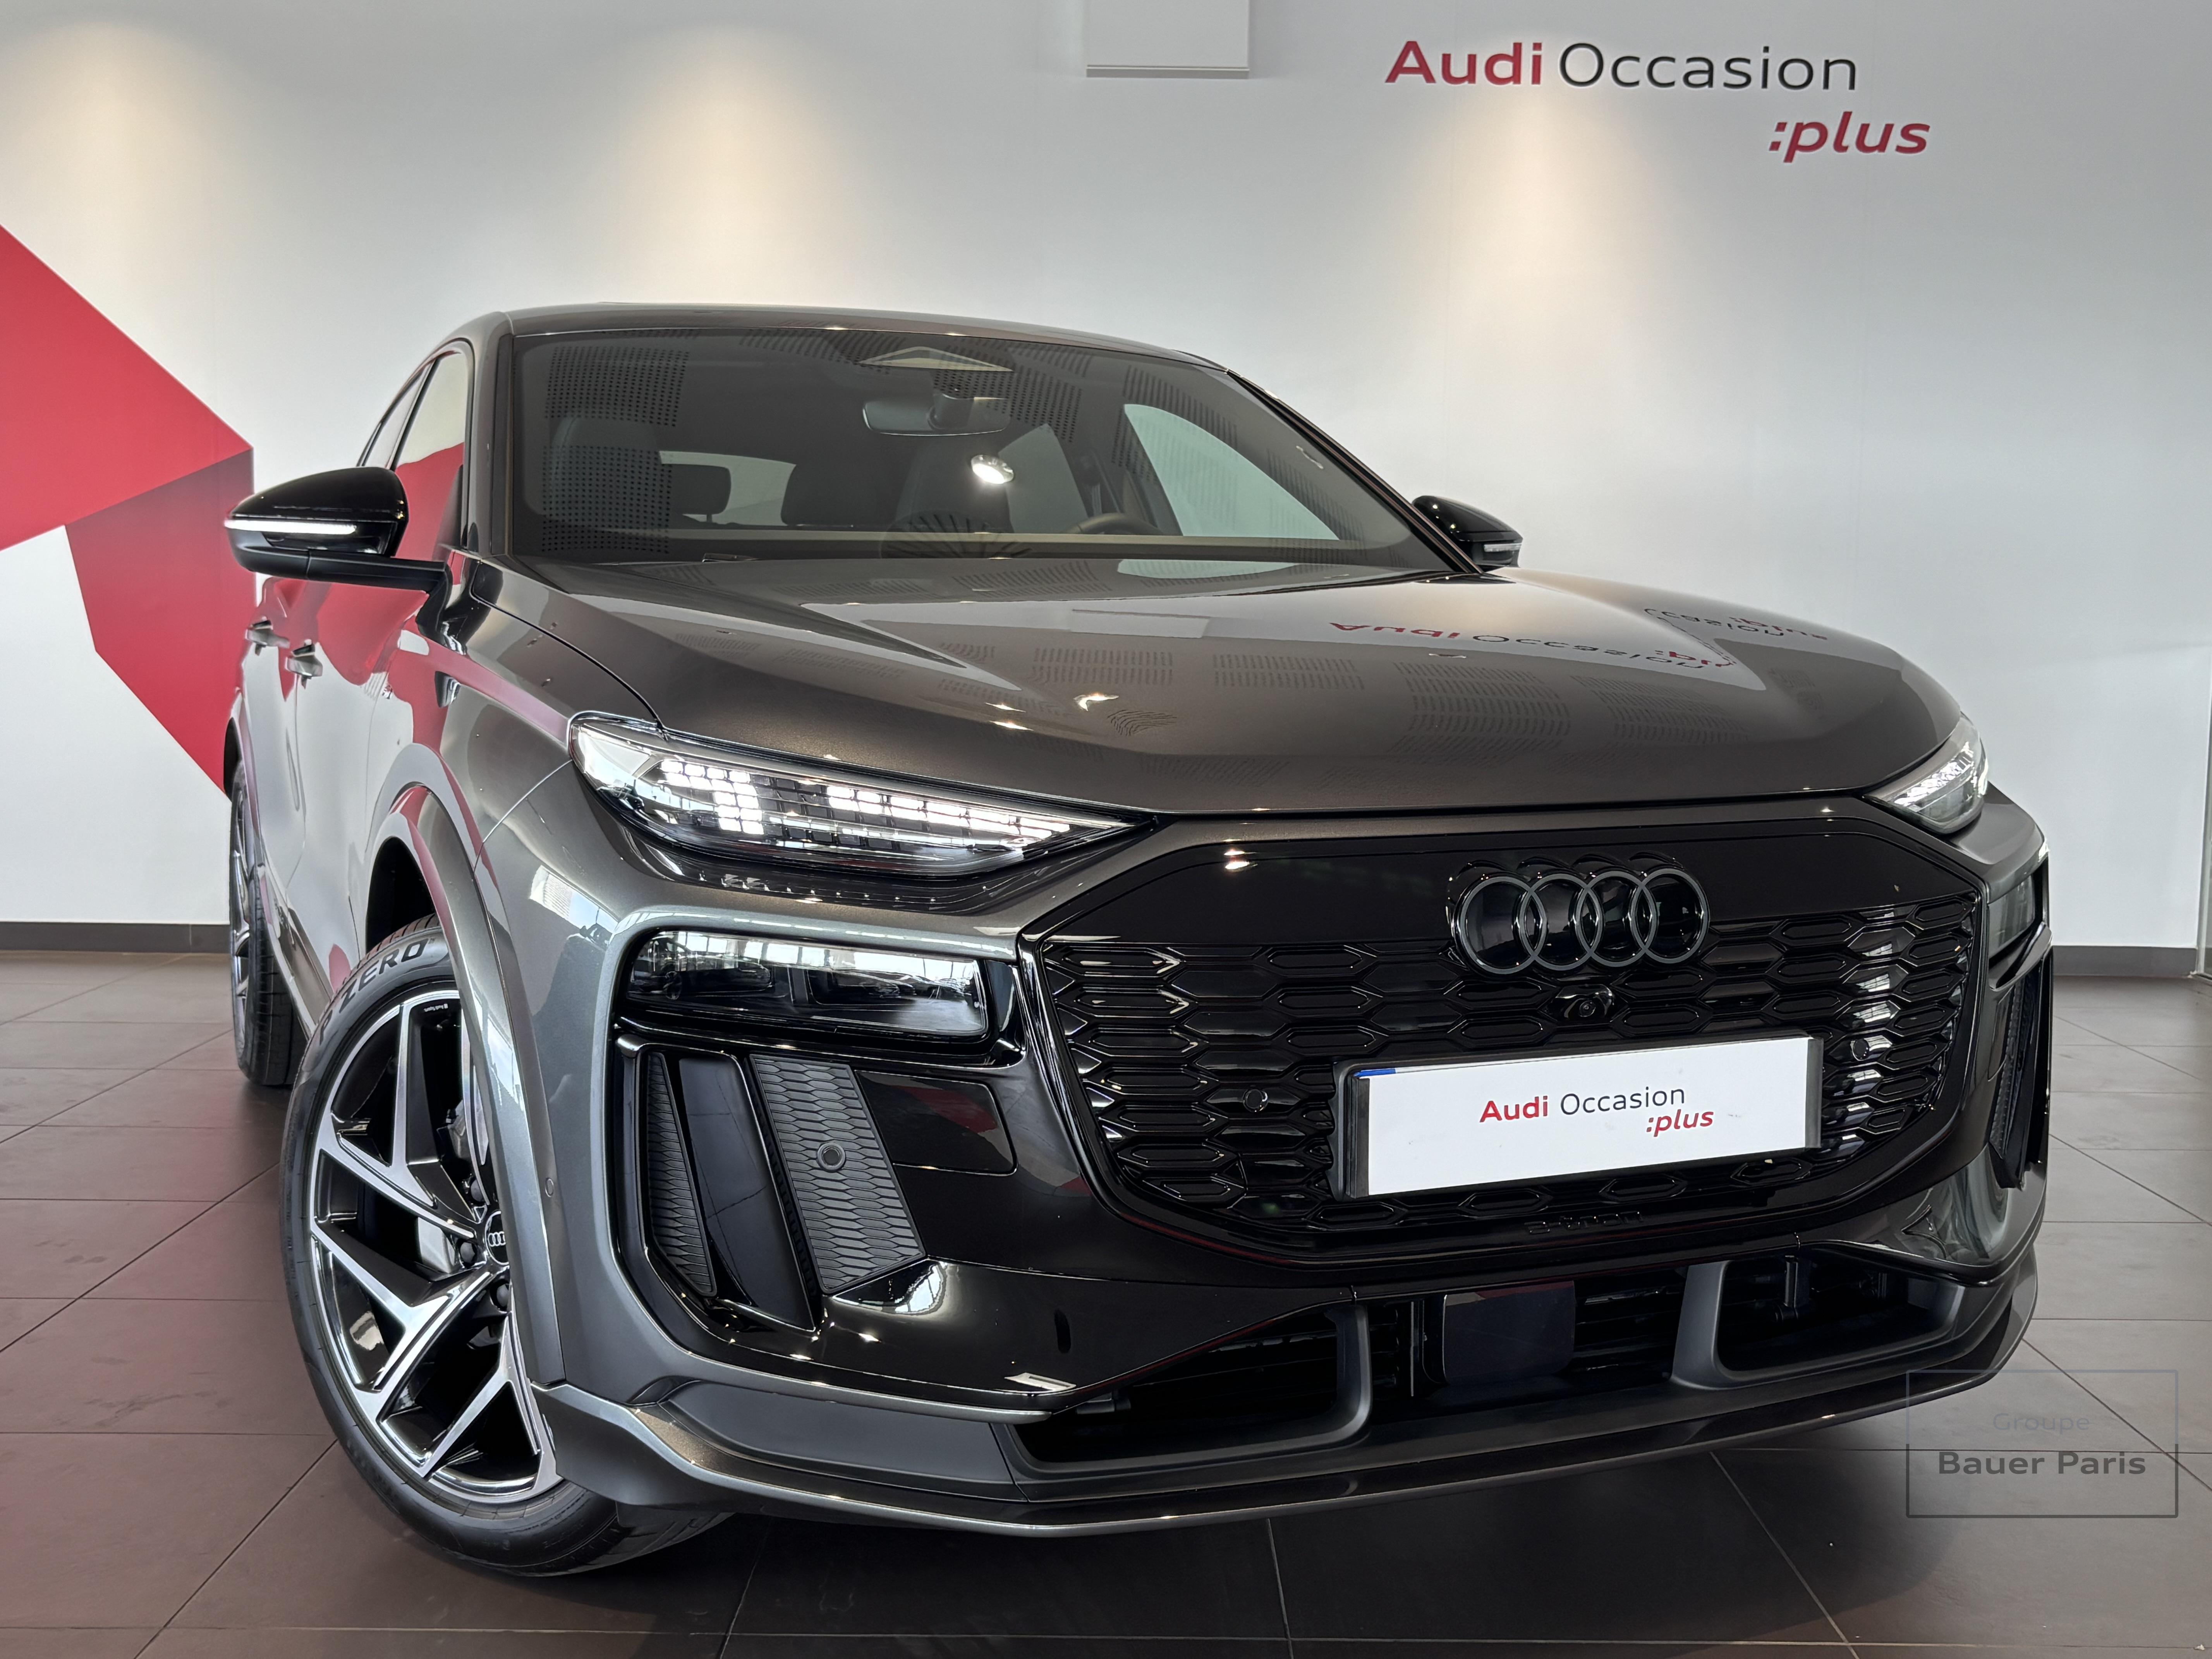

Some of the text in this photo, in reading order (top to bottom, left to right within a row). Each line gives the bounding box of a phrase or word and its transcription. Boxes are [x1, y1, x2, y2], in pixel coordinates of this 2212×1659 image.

[1386, 40, 1856, 90] Audi Occasion
[1769, 111, 1930, 163] :plus
[320, 938, 429, 1046] P ZERO
[1479, 1087, 1685, 1123] Audi Occasion
[1647, 1109, 1714, 1137] :plus
